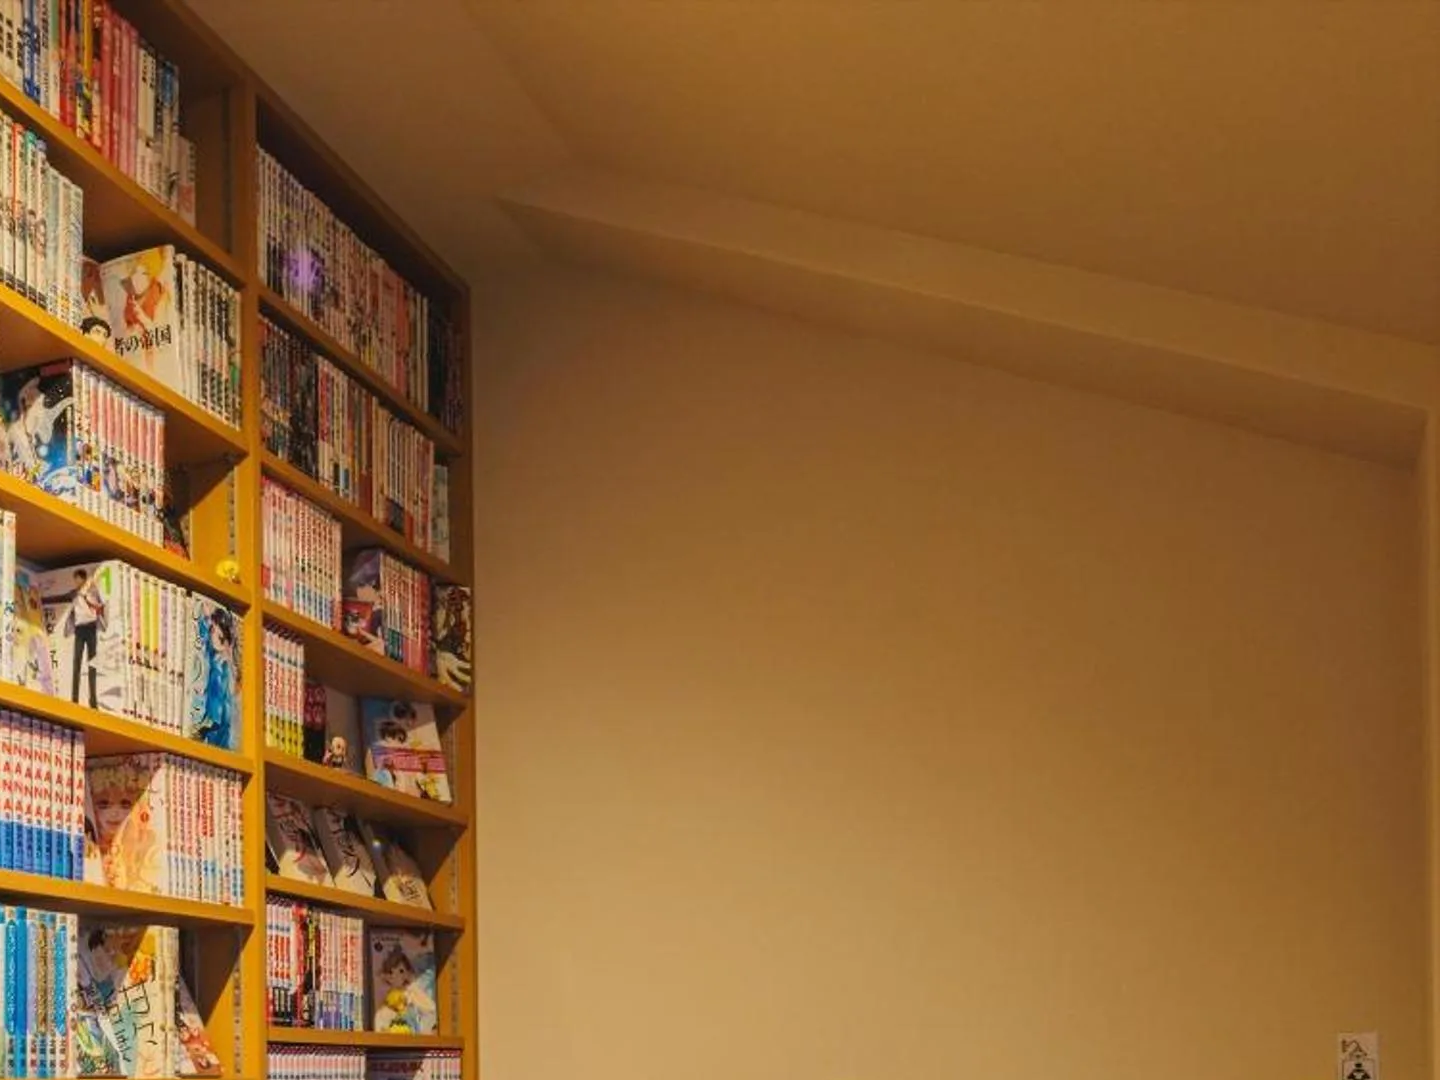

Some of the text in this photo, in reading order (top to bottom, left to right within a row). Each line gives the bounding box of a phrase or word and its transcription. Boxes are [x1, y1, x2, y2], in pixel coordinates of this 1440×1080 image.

[2, 740, 13, 810] NANA
[13, 743, 23, 812] NANA
[23, 745, 33, 815] NANA
[34, 747, 43, 818] NANA
[43, 749, 52, 819] NANA
[54, 753, 63, 821] NANA
[65, 756, 73, 823] NANA
[76, 759, 85, 825] NANA
